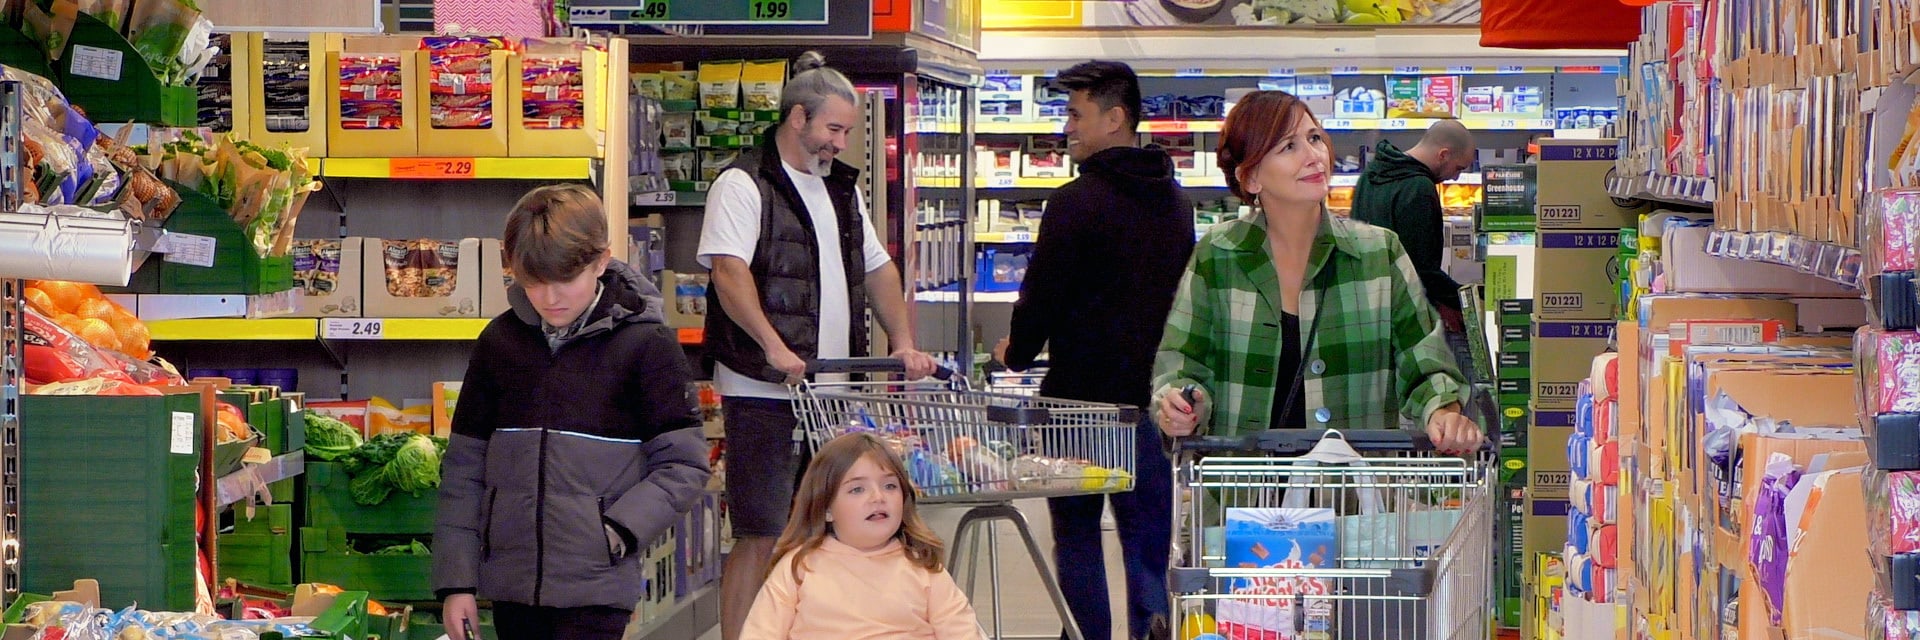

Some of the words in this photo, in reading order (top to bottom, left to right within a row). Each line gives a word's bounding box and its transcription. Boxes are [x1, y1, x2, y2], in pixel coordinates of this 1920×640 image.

[754, 1, 789, 18] 1.99
[1573, 148, 1582, 158] 12
[1586, 148, 1592, 158] X
[1596, 148, 1605, 158] 12
[444, 161, 472, 174] 2.29
[1487, 184, 1525, 193] Greenhouse
[655, 193, 674, 202] 2.39
[1543, 208, 1579, 218] 701221
[1574, 235, 1584, 246] 12
[1587, 235, 1593, 246] X
[1598, 235, 1607, 246] 12
[1544, 296, 1580, 306] 701221
[352, 322, 381, 335] 2.49
[1571, 325, 1580, 335] 12
[1583, 325, 1590, 335] X
[1594, 325, 1603, 335] 12
[1541, 386, 1576, 395] 701221
[1567, 414, 1576, 424] 12
